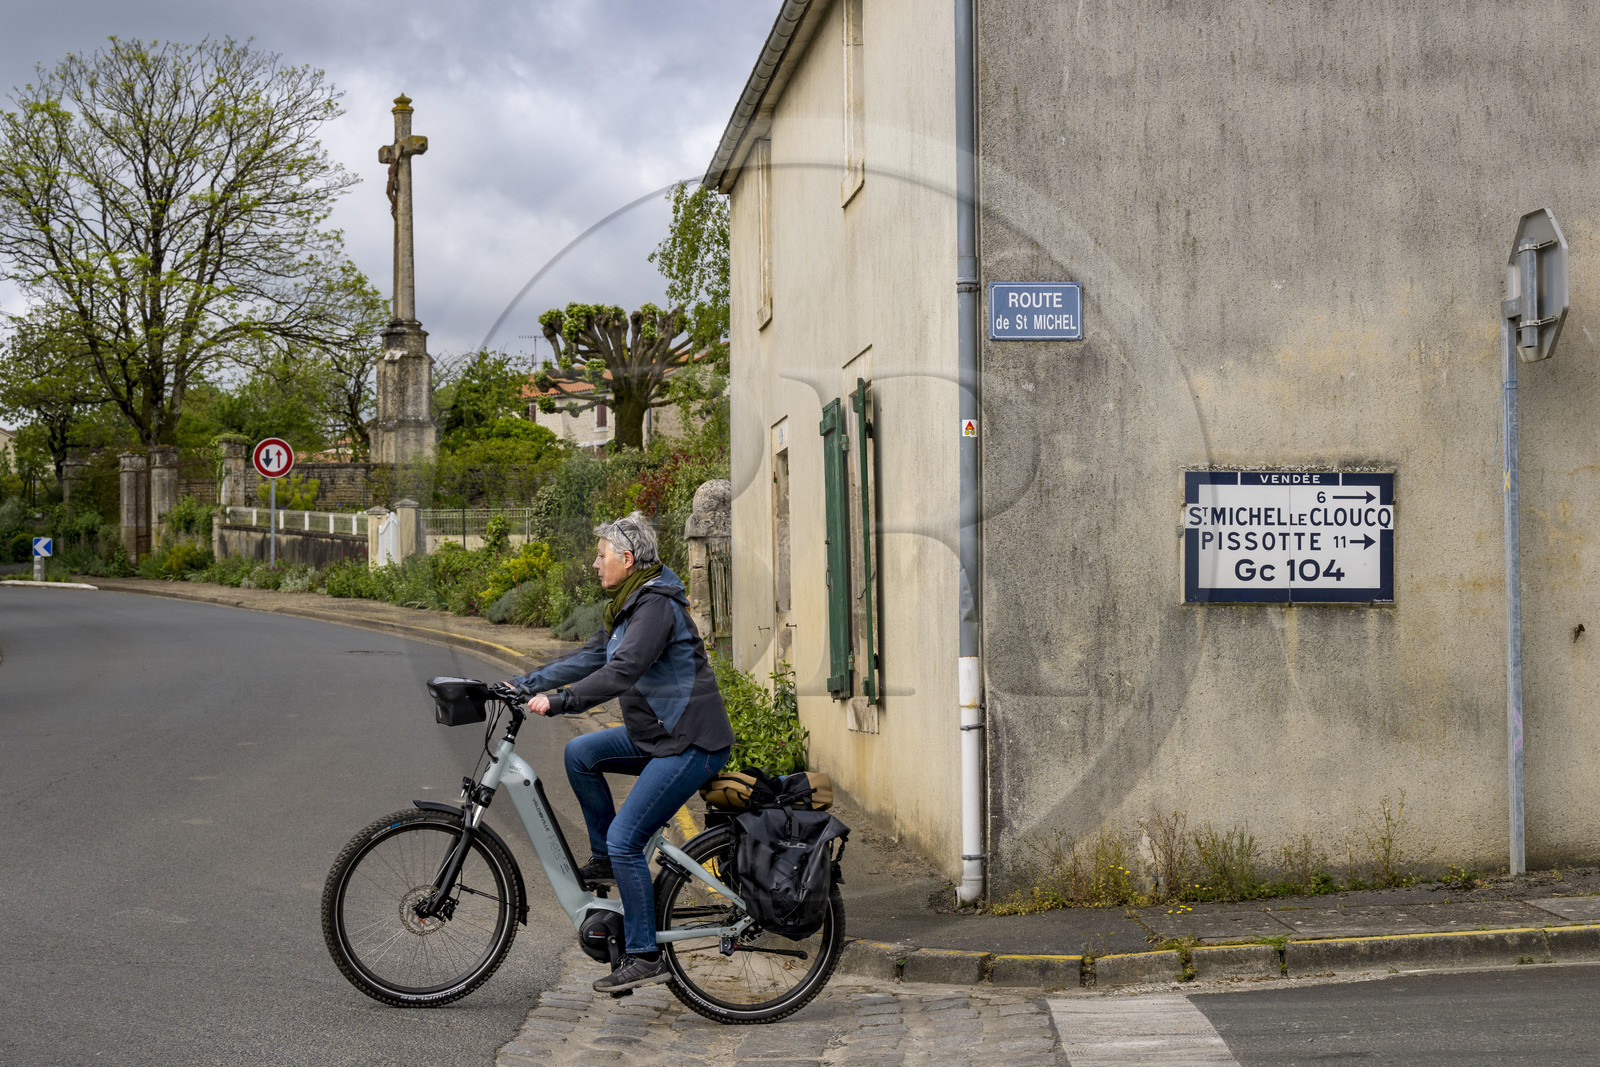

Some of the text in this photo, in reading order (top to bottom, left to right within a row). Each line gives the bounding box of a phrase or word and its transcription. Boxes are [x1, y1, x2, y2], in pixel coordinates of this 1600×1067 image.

[1008, 292, 1063, 308] ROUTE
[995, 314, 1077, 330] de St MICHEL
[1260, 473, 1321, 484] VENDÉE
[1316, 491, 1326, 503] 6
[1201, 531, 1347, 551] PISSOTTE 11
[1234, 559, 1346, 581] Gc 104
